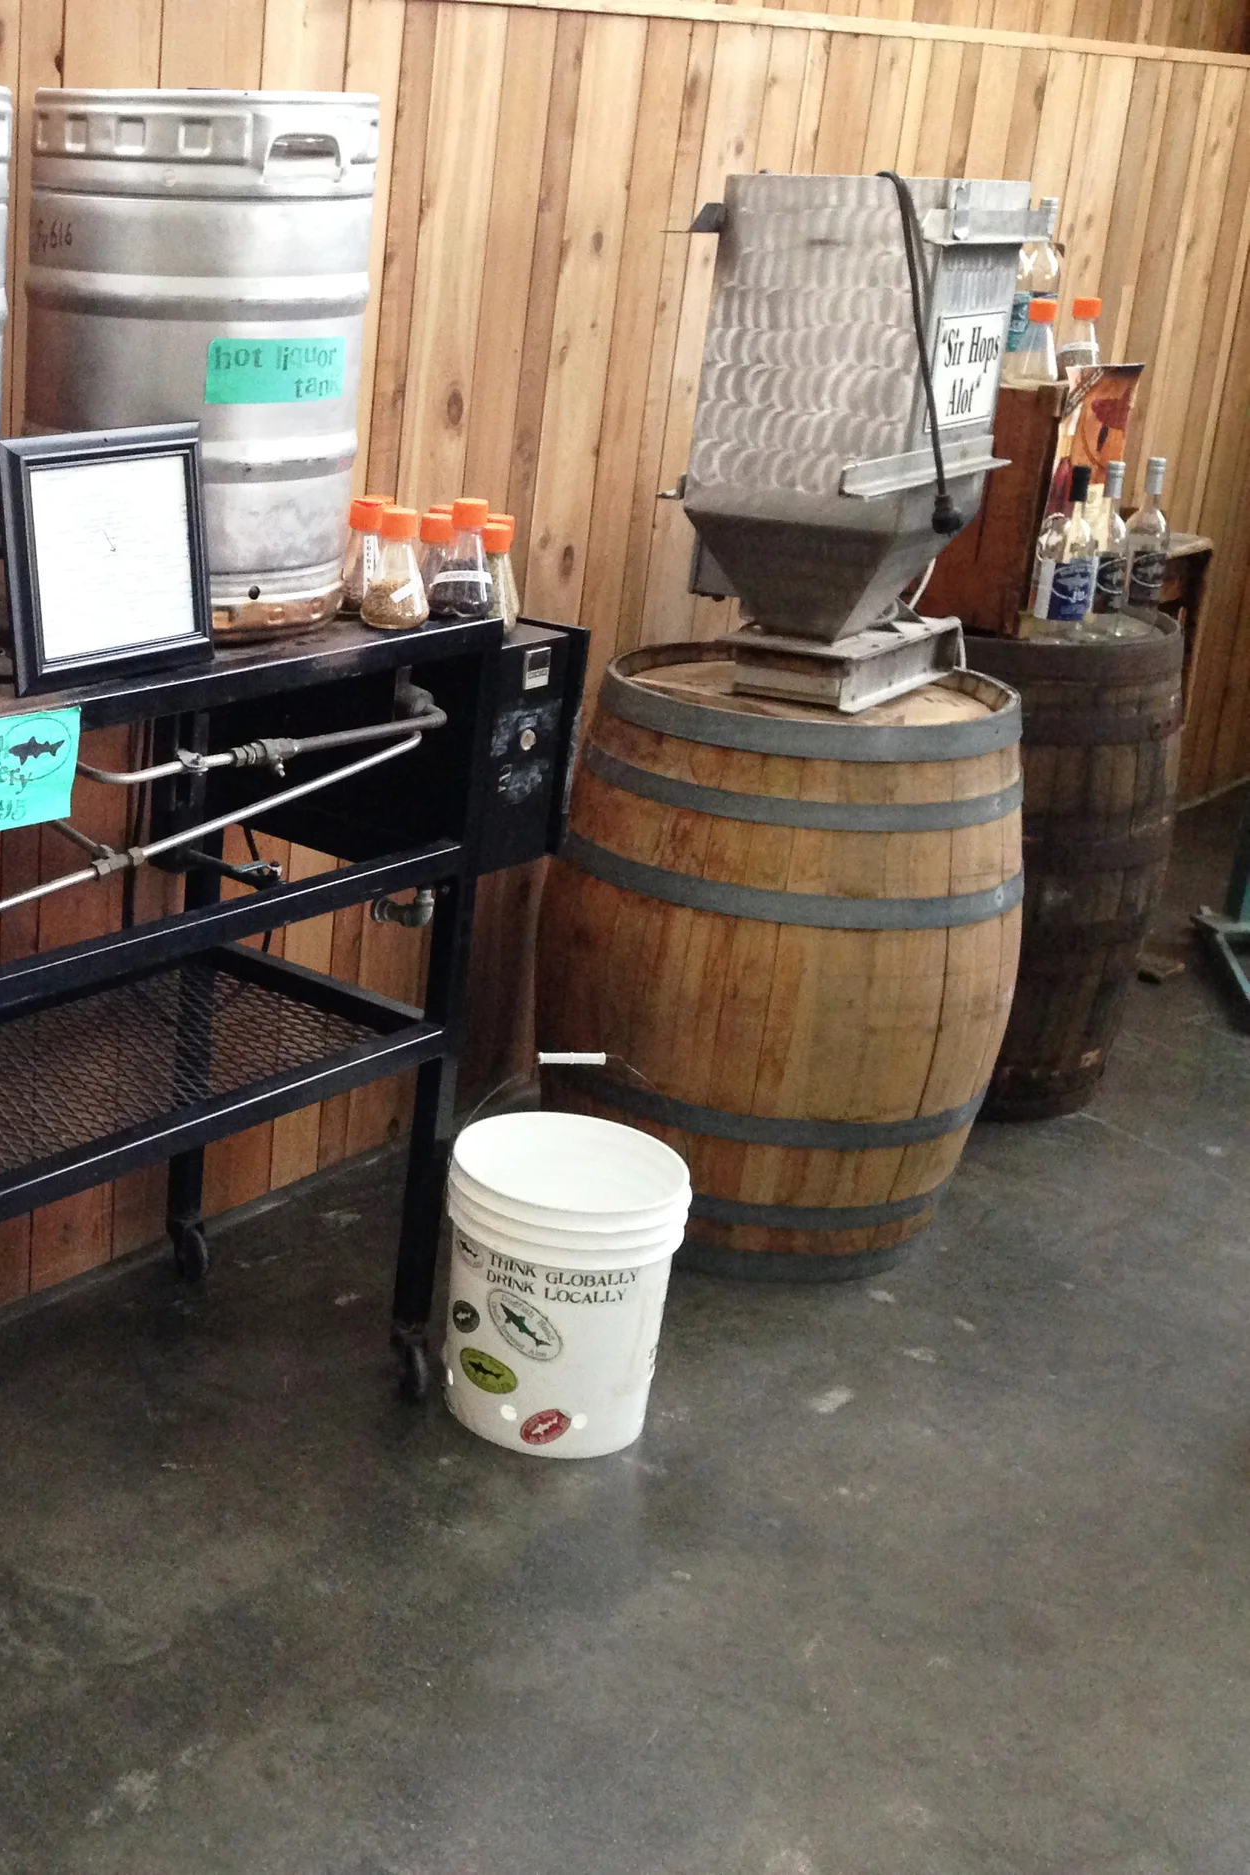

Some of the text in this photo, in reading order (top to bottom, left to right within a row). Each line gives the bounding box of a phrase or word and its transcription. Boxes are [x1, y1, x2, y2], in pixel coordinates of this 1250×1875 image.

[213, 345, 337, 371] hot liquor
[968, 326, 1001, 373] Hops
[486, 1270, 627, 1304] DRINK LOCALLY
[488, 1251, 639, 1288] THINK GLOBALLY
